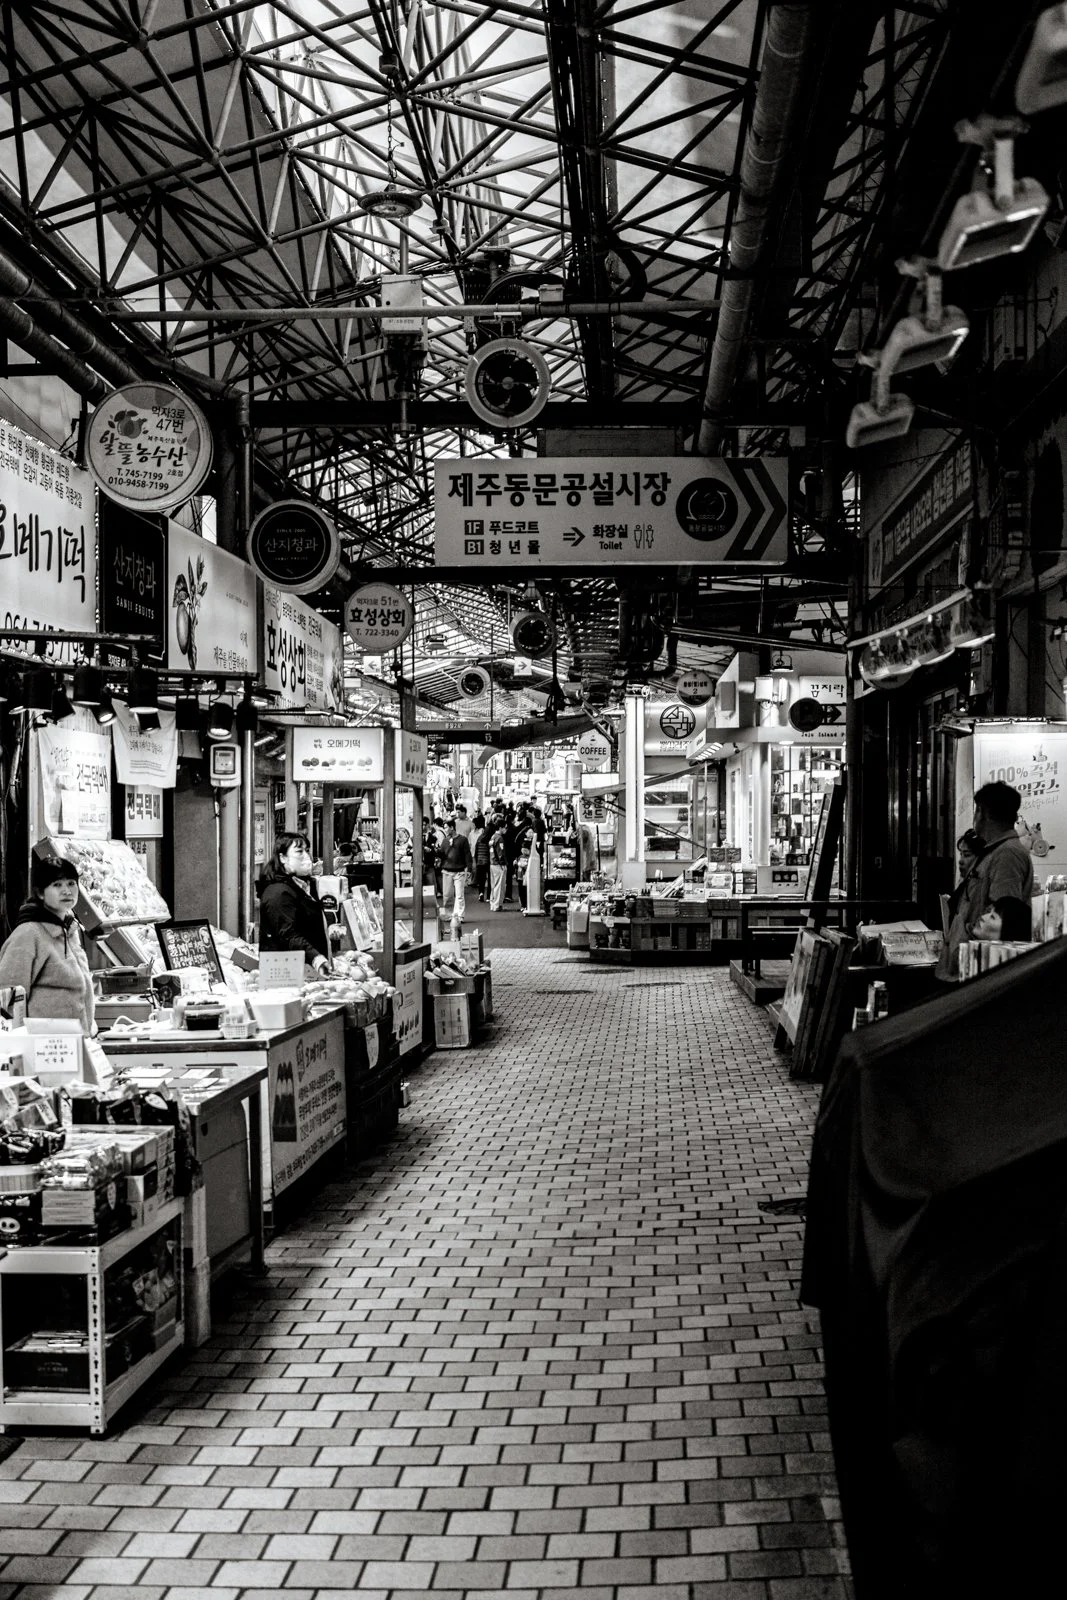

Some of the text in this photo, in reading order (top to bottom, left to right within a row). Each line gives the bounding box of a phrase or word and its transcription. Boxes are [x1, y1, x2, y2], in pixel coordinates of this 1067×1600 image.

[152, 405, 185, 419] 먹자3로
[156, 419, 184, 434] 47번
[99, 430, 188, 467] 알뜰농수산
[125, 469, 163, 480] 745-7199
[108, 476, 169, 490] 010-9458-7199
[448, 471, 671, 507] 제주동문공설시장
[466, 521, 483, 534] 1F
[489, 520, 540, 535] 푸드코트
[592, 524, 628, 539] 화장실
[264, 536, 319, 553] 산지청과
[466, 540, 483, 554] B1
[598, 540, 623, 550] Toilet
[113, 545, 156, 599] 산지청과
[116, 595, 155, 620] SANJI FRUITS
[349, 607, 406, 627] 효성상회
[355, 628, 400, 637] T. 722-3340
[266, 619, 306, 697] 효성상회
[327, 739, 361, 749] 오메기떡
[580, 746, 607, 755] COFFEE
[76, 763, 108, 794] 전국택배
[990, 767, 1028, 783] 100%
[1014, 779, 1060, 797] 일쥬스
[126, 793, 161, 820] 전국택배
[583, 809, 604, 819] 샌드
